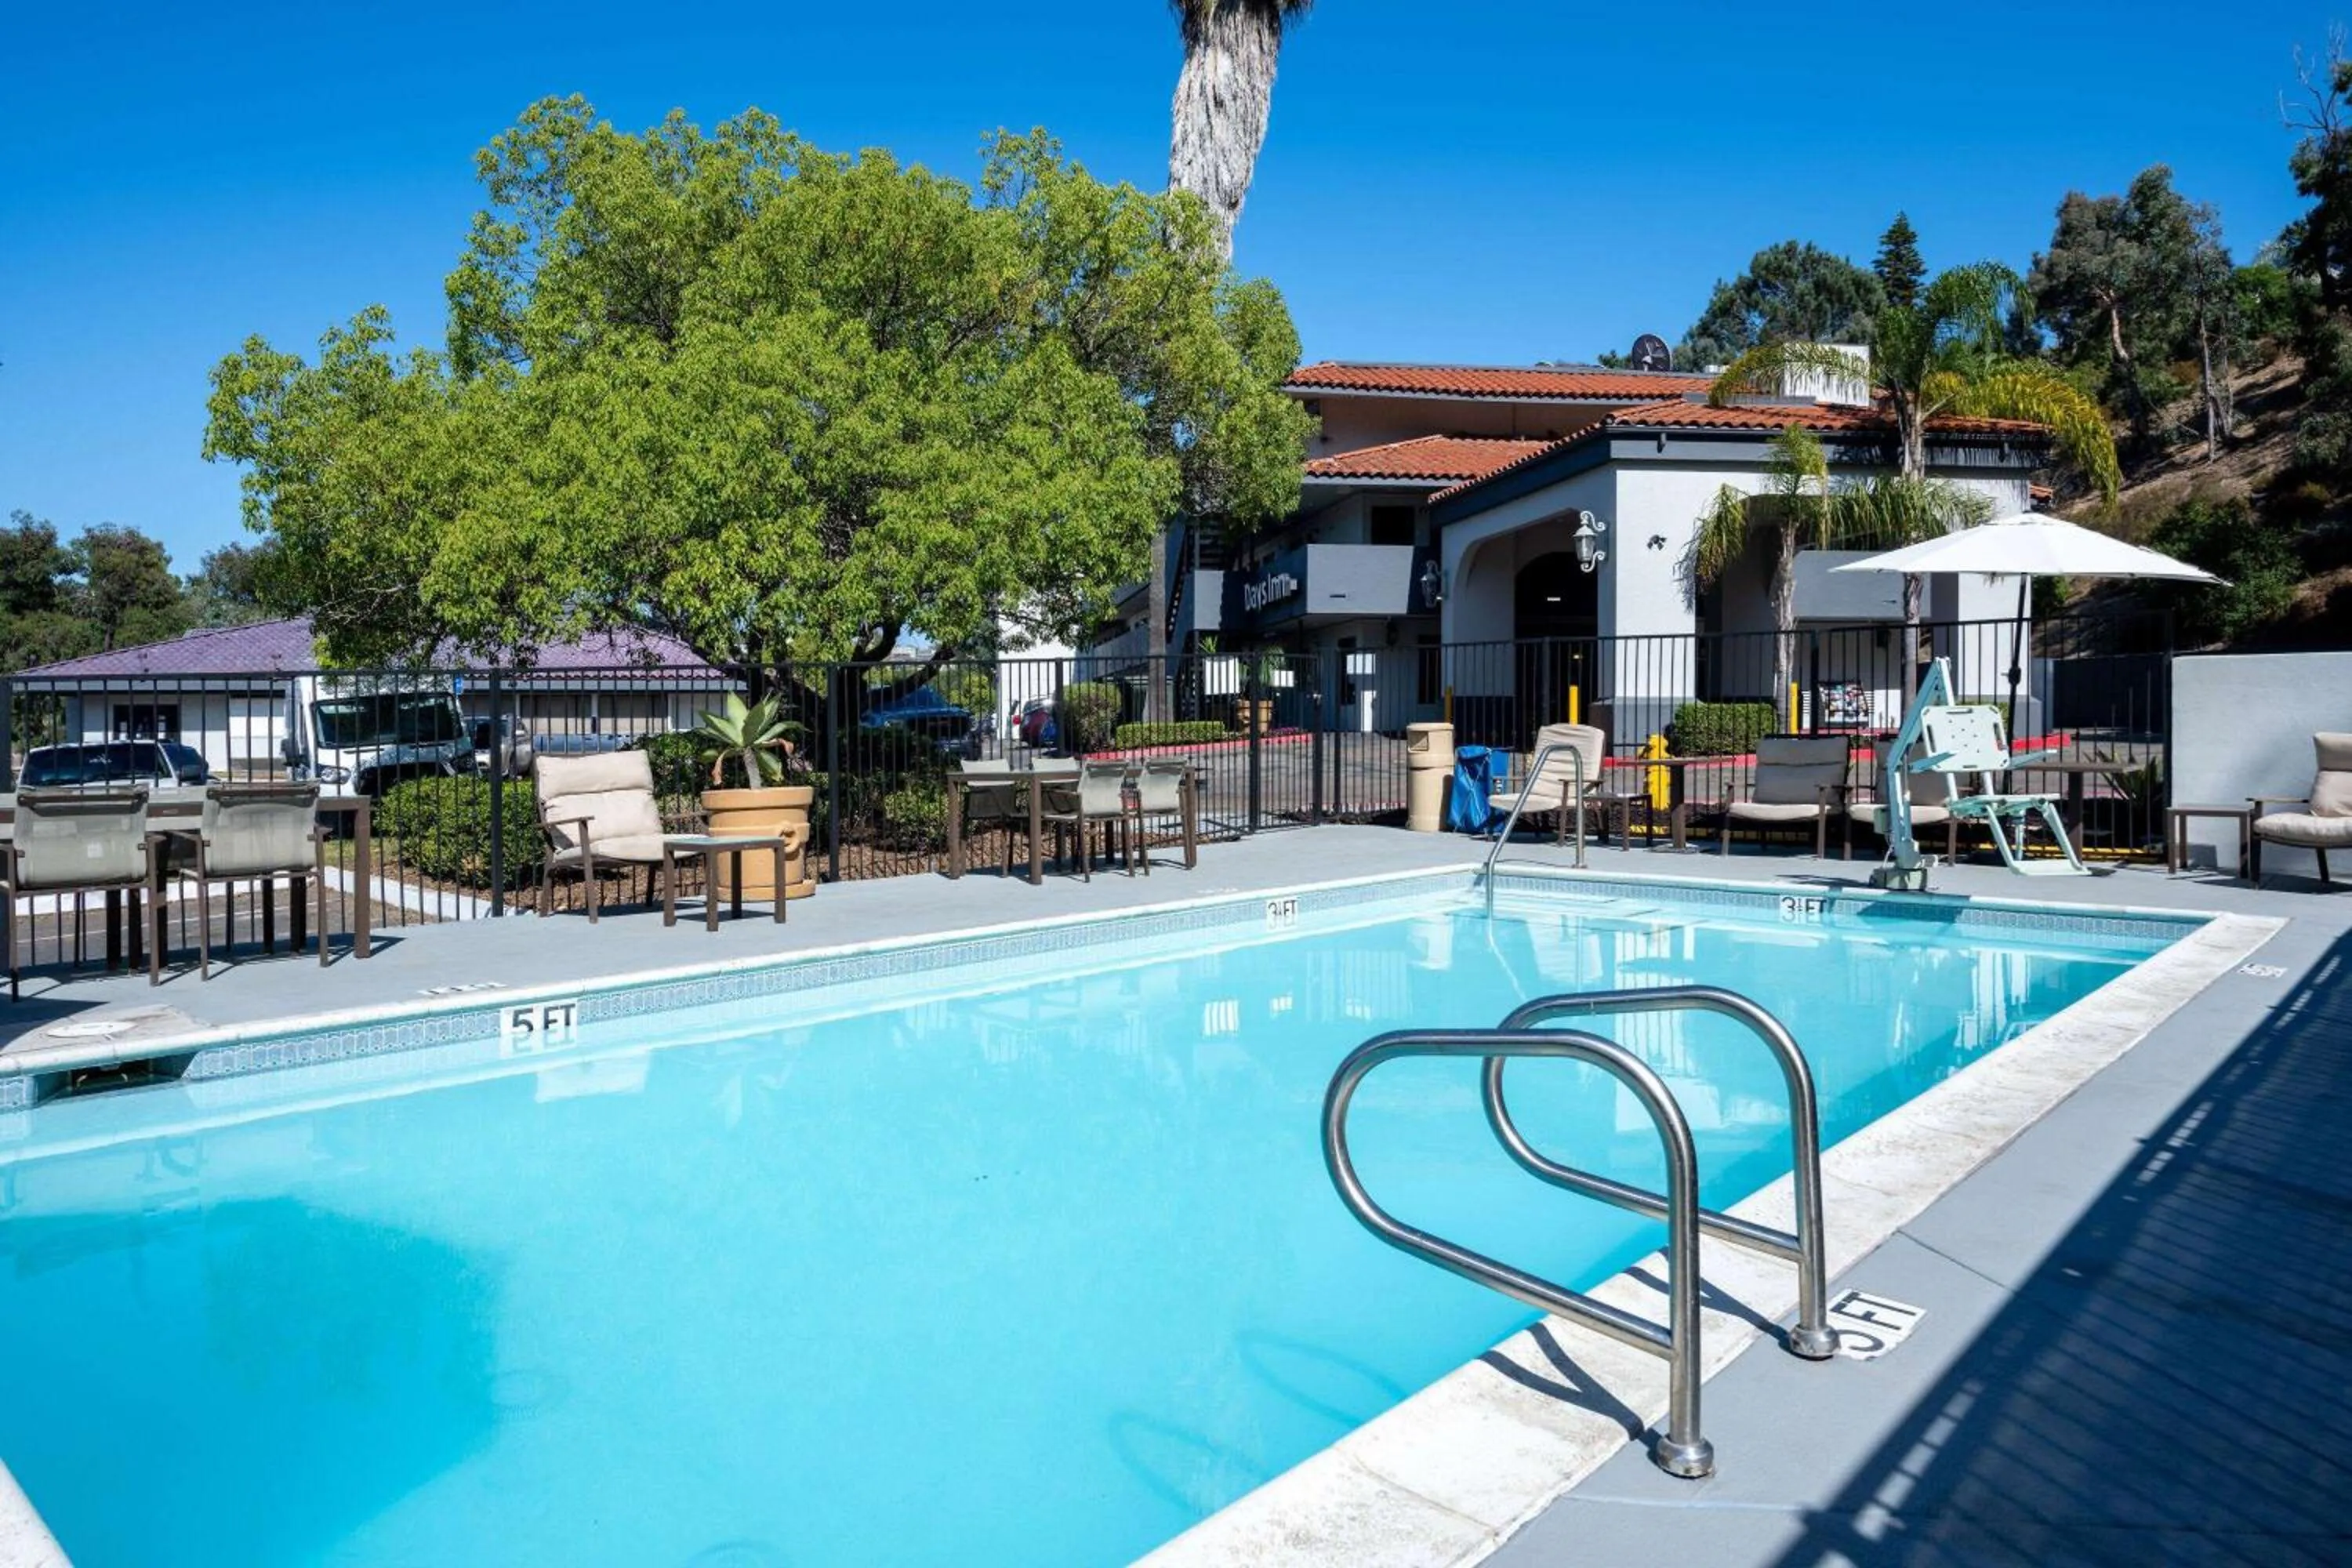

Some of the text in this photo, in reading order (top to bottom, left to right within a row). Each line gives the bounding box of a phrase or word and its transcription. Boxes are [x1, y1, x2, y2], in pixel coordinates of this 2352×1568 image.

[1244, 573, 1290, 612] Days Inn
[1283, 899, 1298, 916] FT
[1806, 898, 1828, 913] FT
[512, 1004, 576, 1033] 5 FT
[1829, 1291, 1917, 1330] FT
